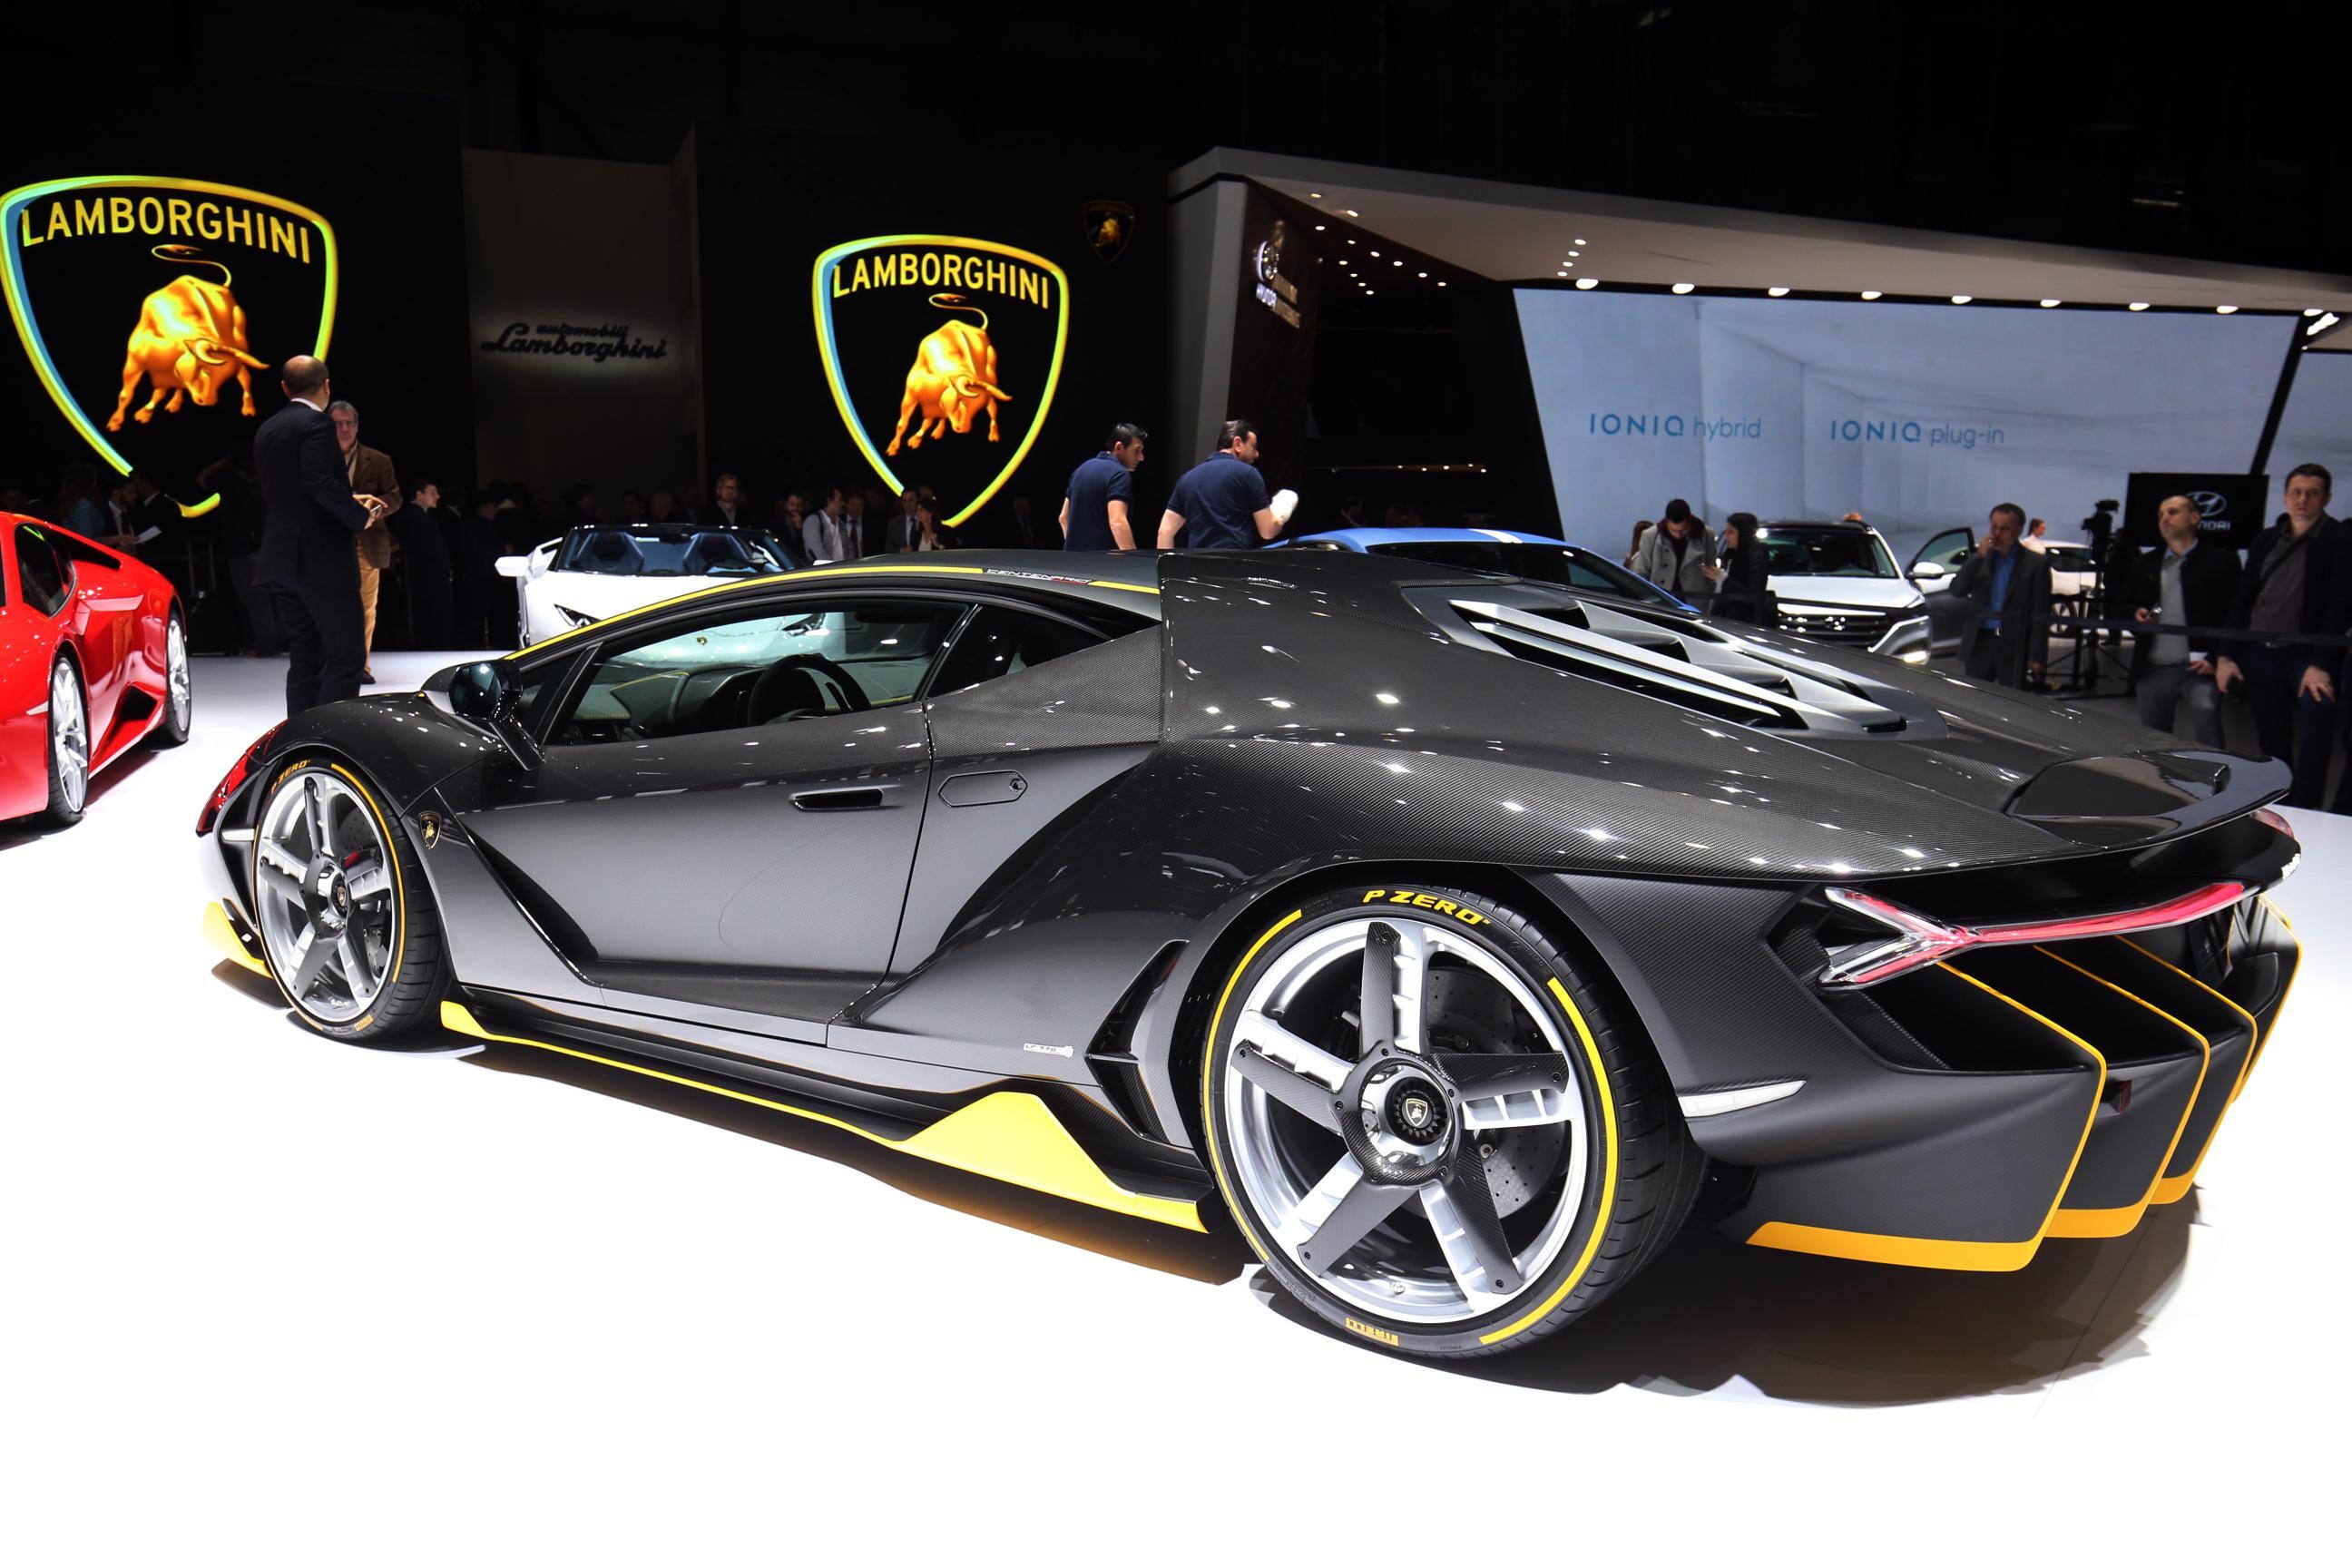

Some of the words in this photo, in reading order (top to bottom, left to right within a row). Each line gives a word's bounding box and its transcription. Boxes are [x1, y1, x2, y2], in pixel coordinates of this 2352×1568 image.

[20, 197, 311, 263] LAMBORGHINI
[832, 252, 1049, 309] LAMBORGHINI
[481, 322, 667, 363] Lamborghini
[536, 322, 629, 338] automobili
[1589, 414, 1685, 437] IONIQ
[1692, 417, 1762, 443] hybrid
[1830, 419, 1922, 443] IONIQ
[1930, 424, 2005, 449] plug-in
[986, 568, 1091, 584] CENTENARIO
[1362, 889, 1386, 904] P
[1345, 1317, 1399, 1348] PIRELLI
